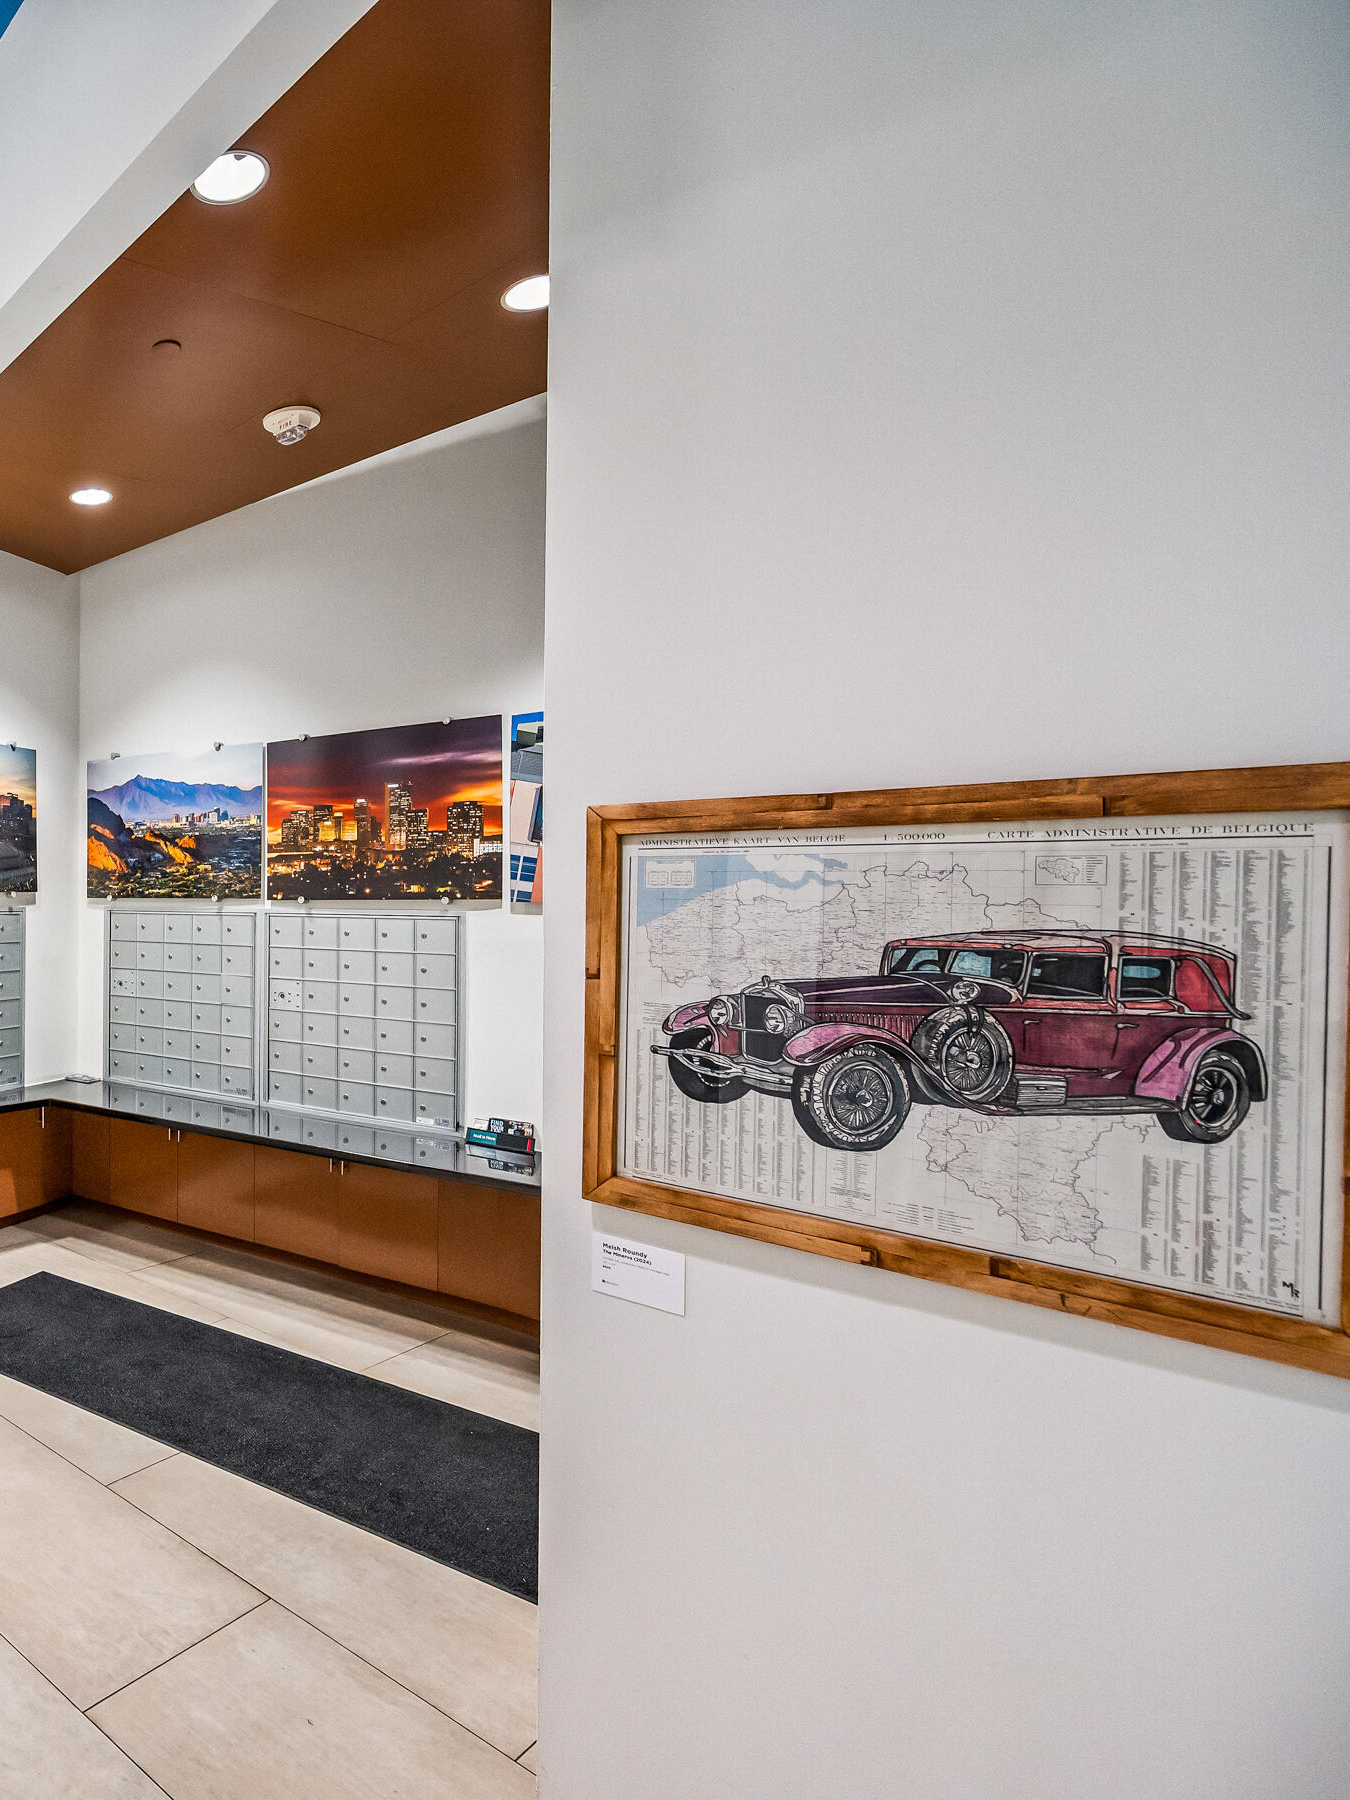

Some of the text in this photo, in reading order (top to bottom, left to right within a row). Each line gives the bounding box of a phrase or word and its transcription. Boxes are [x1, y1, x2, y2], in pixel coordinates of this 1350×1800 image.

[987, 823, 1314, 839] CARTE ADMINISTRATIVE DE BELGIQUE
[640, 838, 729, 847] ADMINISTRATIEVE
[734, 836, 771, 845] KAART
[777, 836, 800, 844] VAN
[603, 1248, 612, 1256] The
[613, 1251, 633, 1261] Minerva
[633, 1256, 652, 1266] (2024)
[622, 1247, 648, 1259] Roundy
